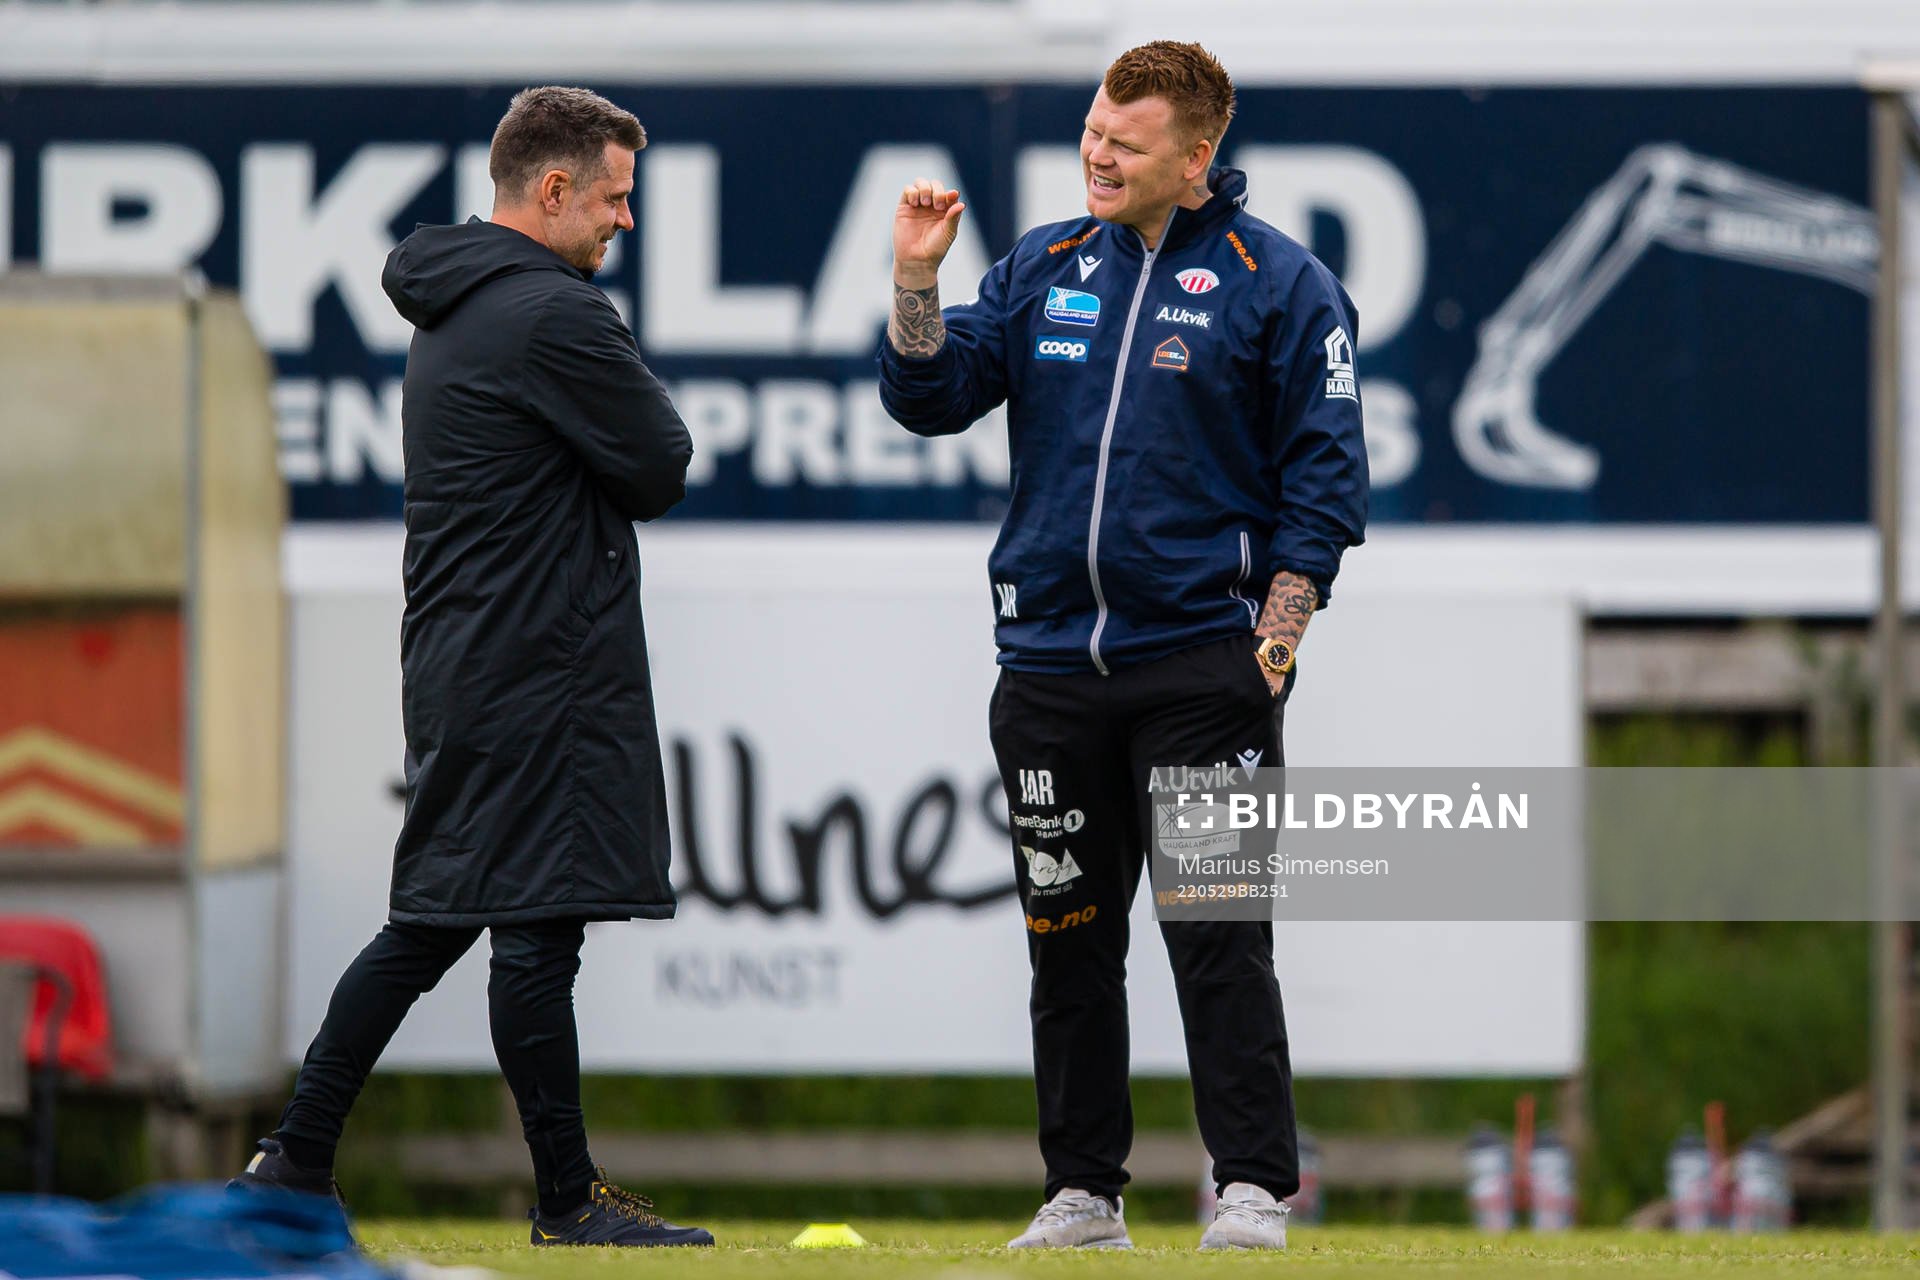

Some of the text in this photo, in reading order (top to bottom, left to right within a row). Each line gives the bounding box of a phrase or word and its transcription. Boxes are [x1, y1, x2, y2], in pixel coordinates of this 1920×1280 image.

[1226, 231, 1257, 271] wee.no
[1156, 306, 1211, 328] A.Utvik
[1038, 340, 1086, 359] coop
[1019, 768, 1055, 806] JAR
[1147, 761, 1238, 793] A.Utvik
[1011, 810, 1062, 830] pareBank
[1163, 834, 1237, 849] HAUGALAND KRAFT
[1026, 904, 1097, 934] e.no
[655, 945, 846, 1001] KUNST
